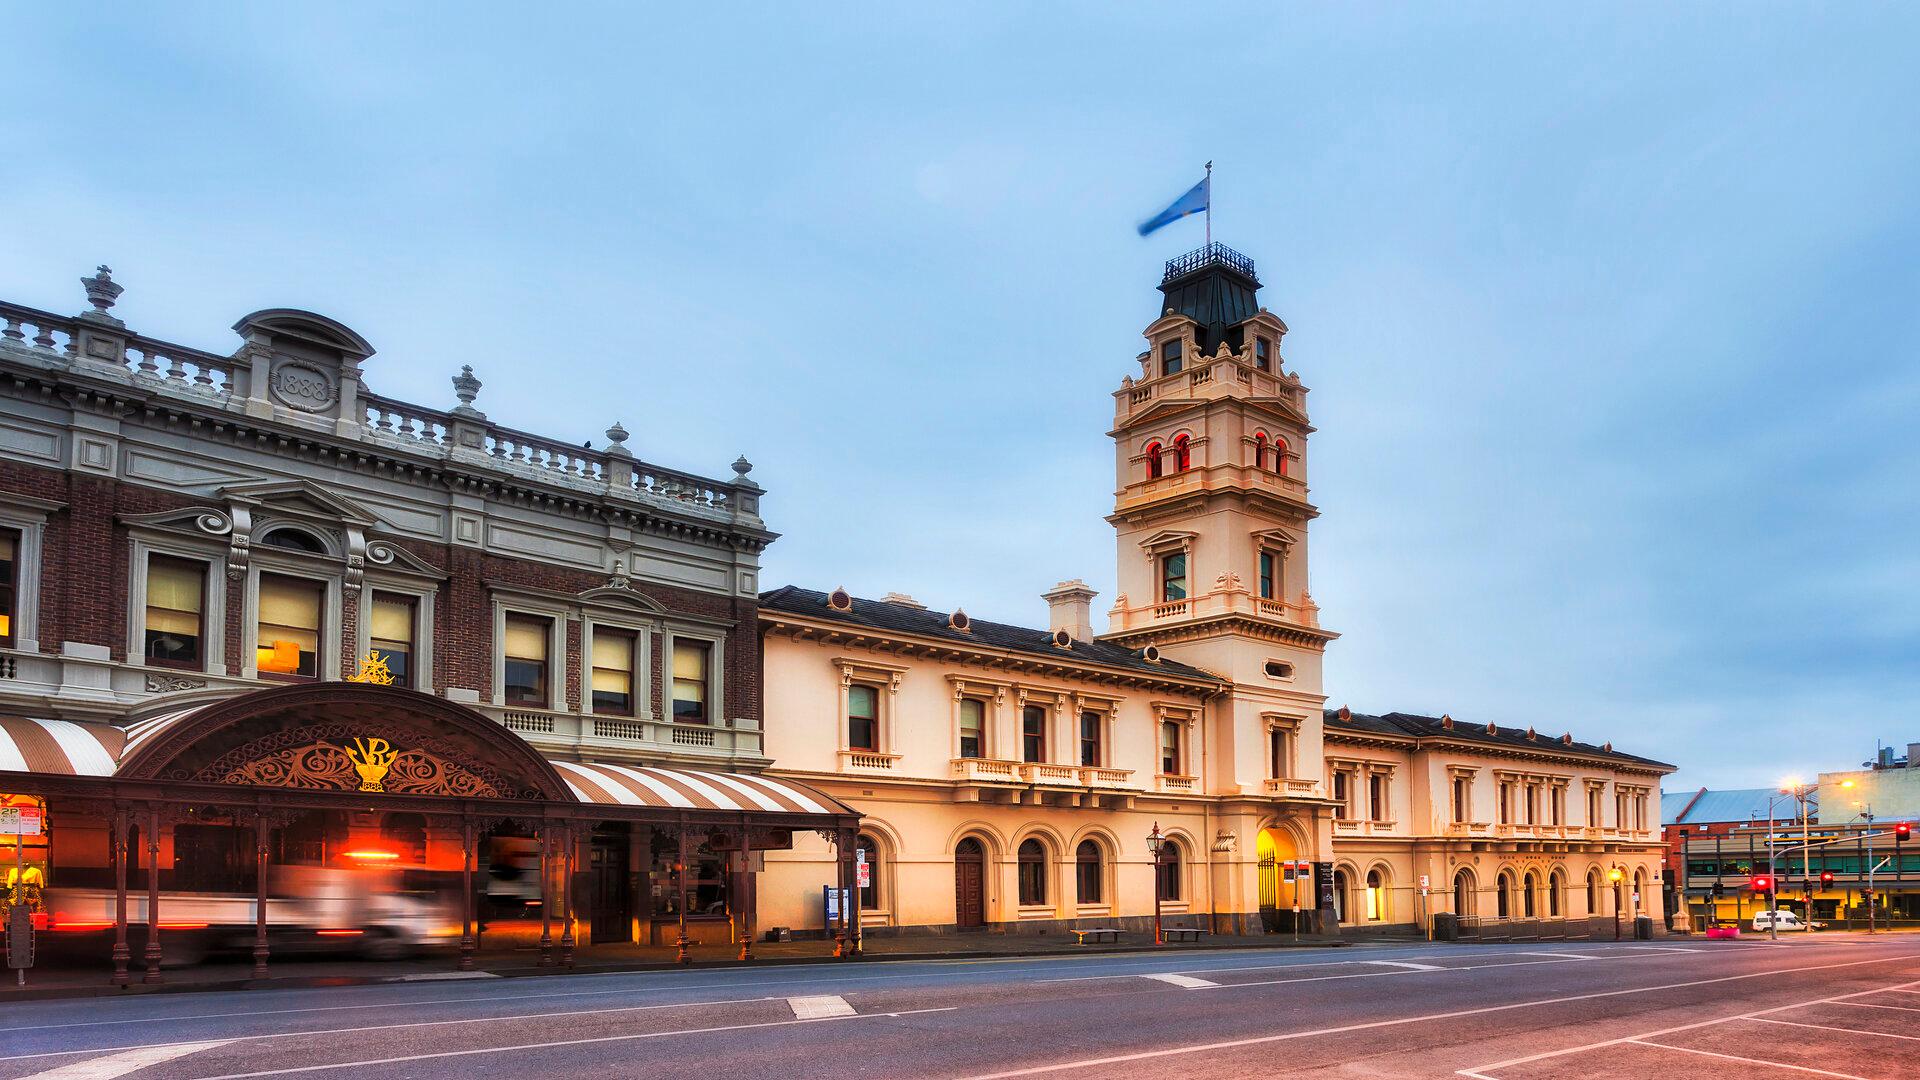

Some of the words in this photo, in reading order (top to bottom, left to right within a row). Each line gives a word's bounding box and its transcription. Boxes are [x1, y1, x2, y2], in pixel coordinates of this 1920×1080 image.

[278, 372, 327, 401] 1888
[361, 782, 383, 792] 1888
[1, 807, 19, 815] 2P
